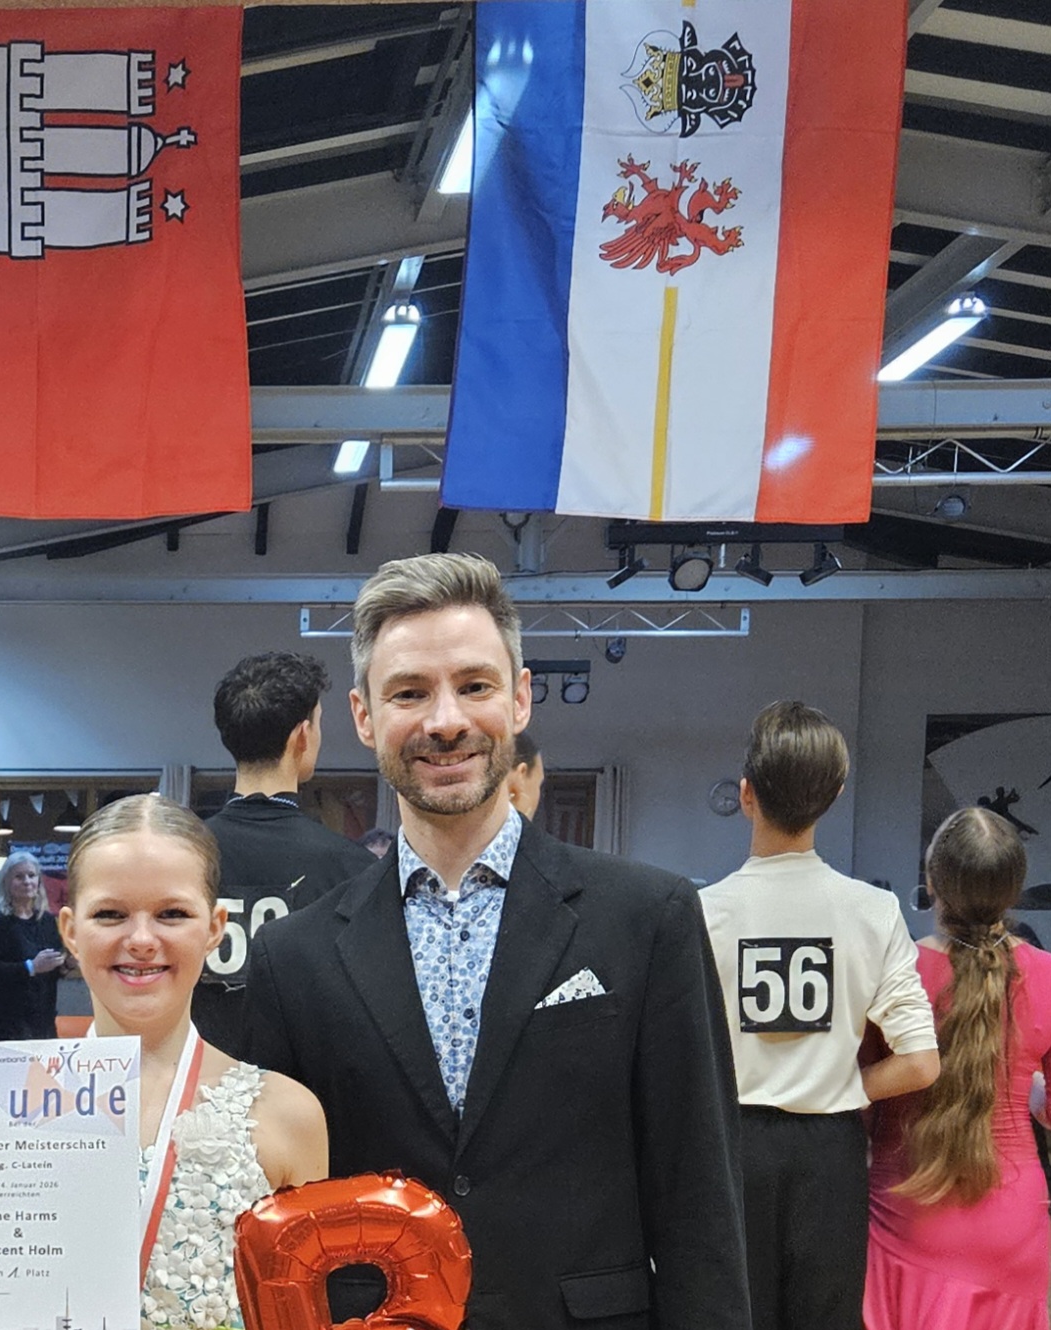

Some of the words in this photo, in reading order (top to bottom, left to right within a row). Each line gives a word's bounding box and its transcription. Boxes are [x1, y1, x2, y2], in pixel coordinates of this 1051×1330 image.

[741, 946, 829, 1023] 56
[77, 1057, 133, 1073] HATV
[15, 1137, 106, 1150] Meisterschaft
[11, 1160, 53, 1169] C-Latein
[0, 1190, 41, 1198] erreichten
[15, 1210, 58, 1222] Harms
[13, 1227, 23, 1239] &
[28, 1244, 64, 1256] Holm
[26, 1268, 50, 1278] Platz
